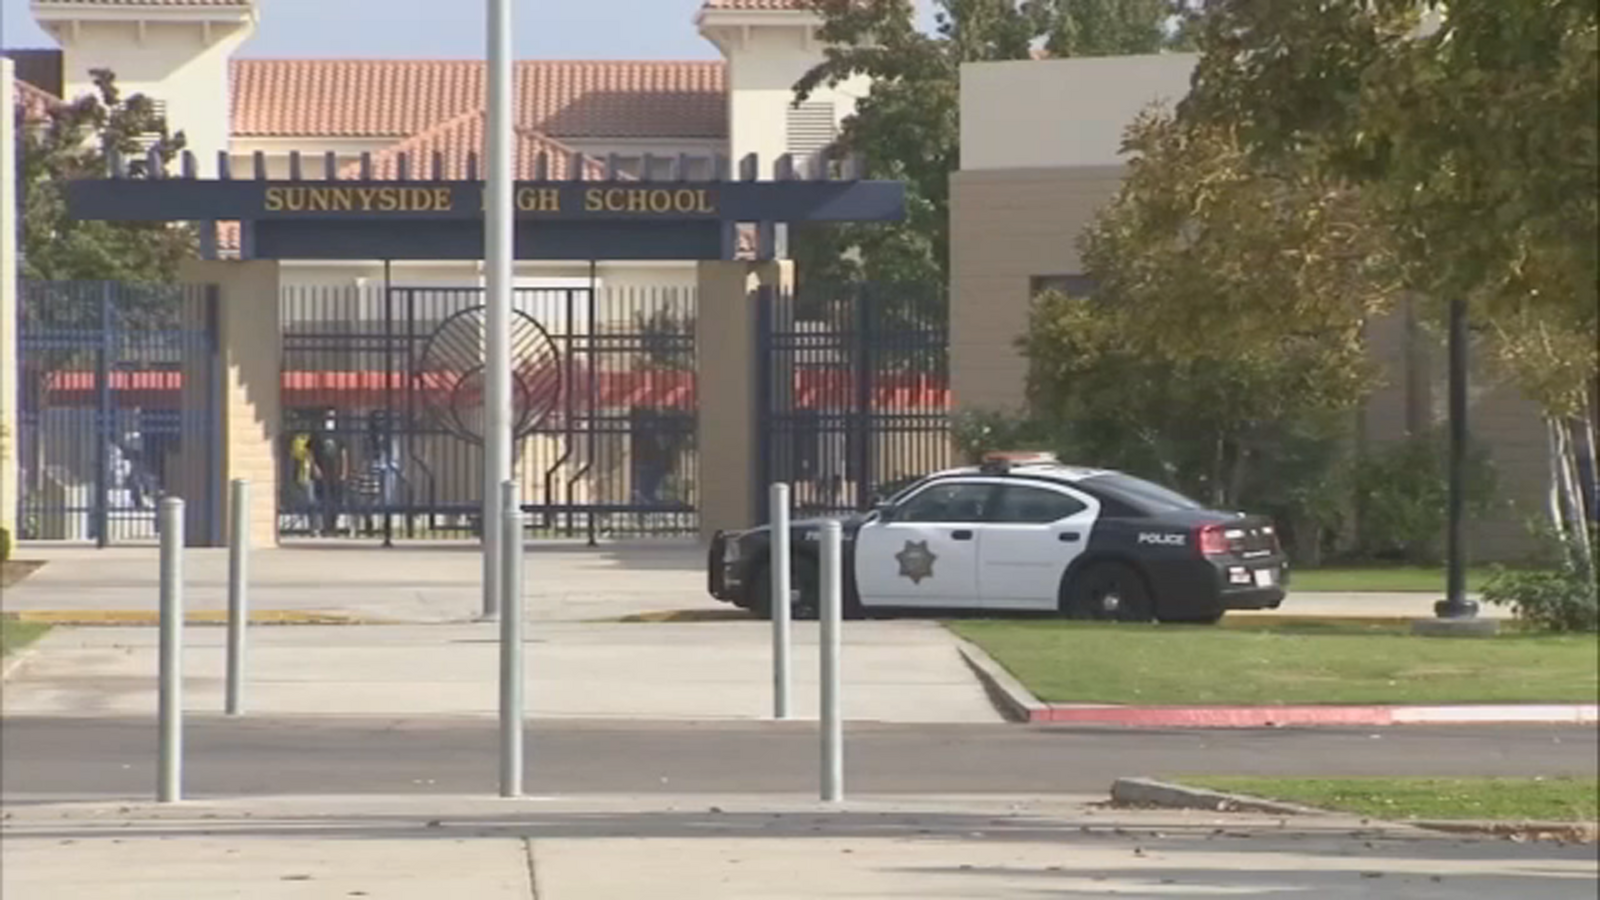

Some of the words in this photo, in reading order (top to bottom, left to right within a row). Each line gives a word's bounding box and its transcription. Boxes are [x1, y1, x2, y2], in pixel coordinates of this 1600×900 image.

[264, 187, 452, 211] SUNNYSIDE
[480, 187, 560, 211] GH
[584, 188, 714, 213] SCHOOL
[1137, 531, 1186, 546] POLICE
